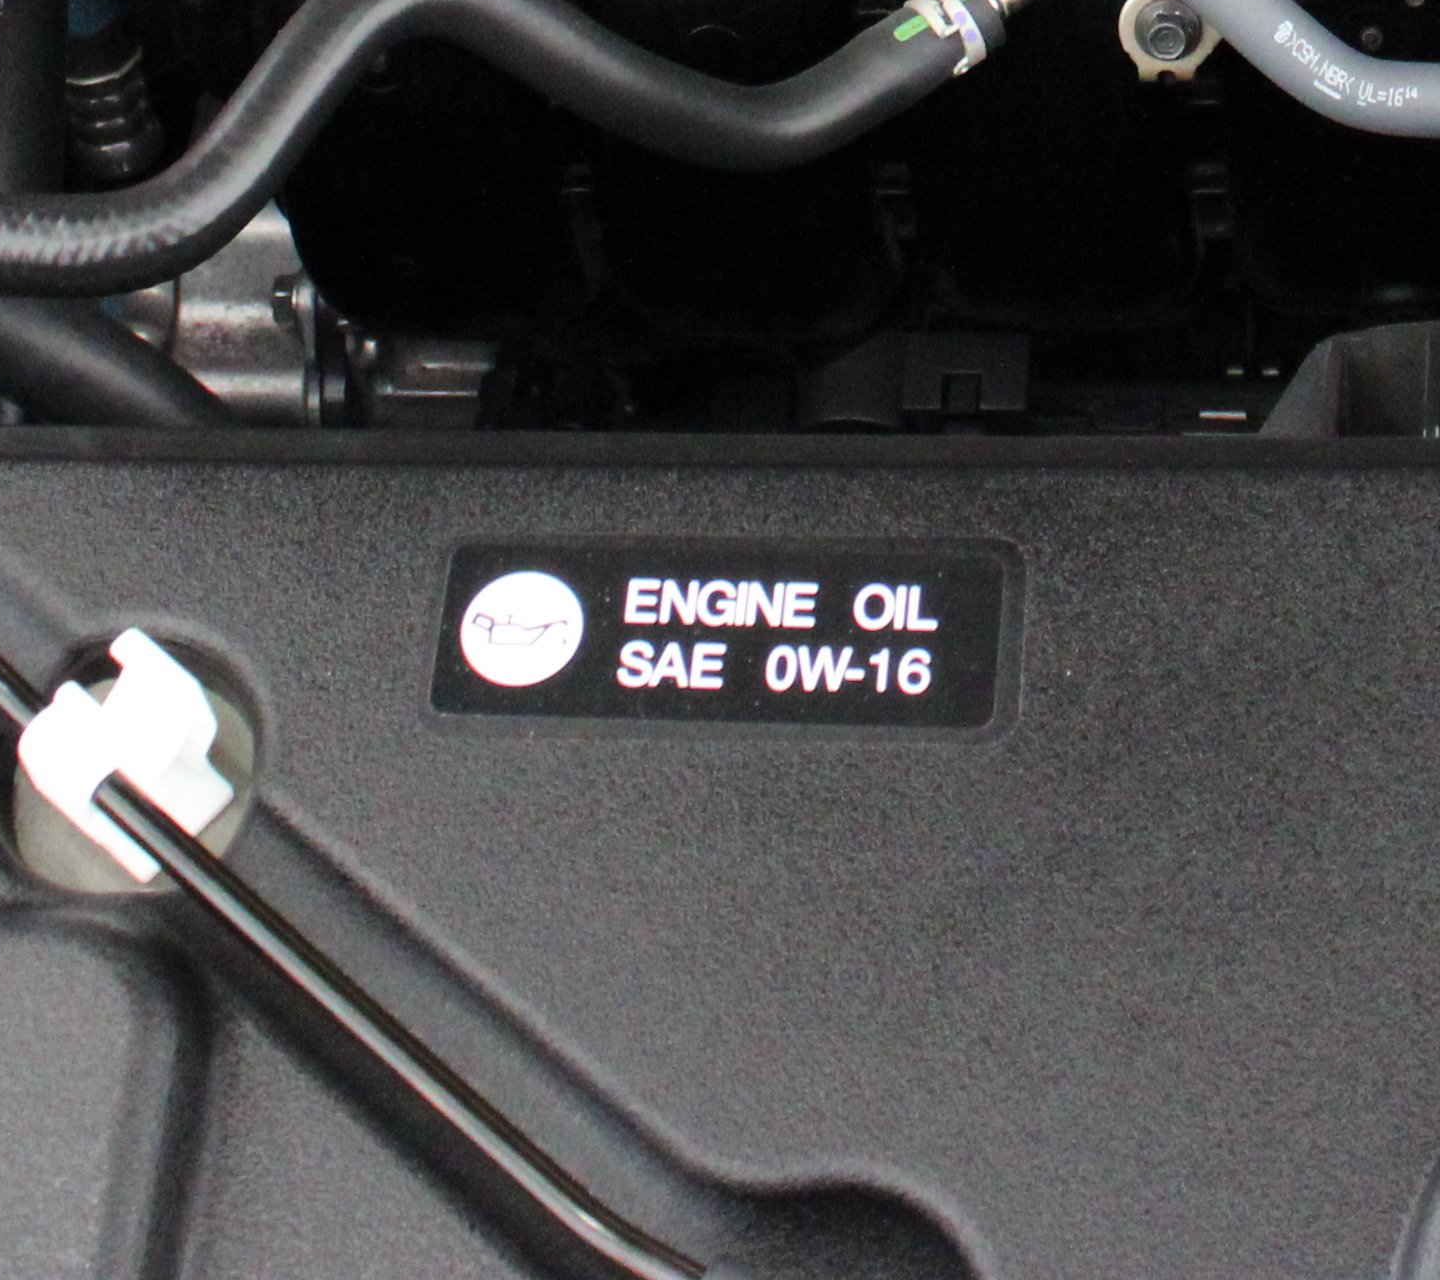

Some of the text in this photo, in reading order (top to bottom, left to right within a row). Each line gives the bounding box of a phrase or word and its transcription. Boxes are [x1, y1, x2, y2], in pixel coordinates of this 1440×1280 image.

[623, 578, 938, 632] ENGINE OIL
[616, 641, 932, 695] SAE 0W-16
